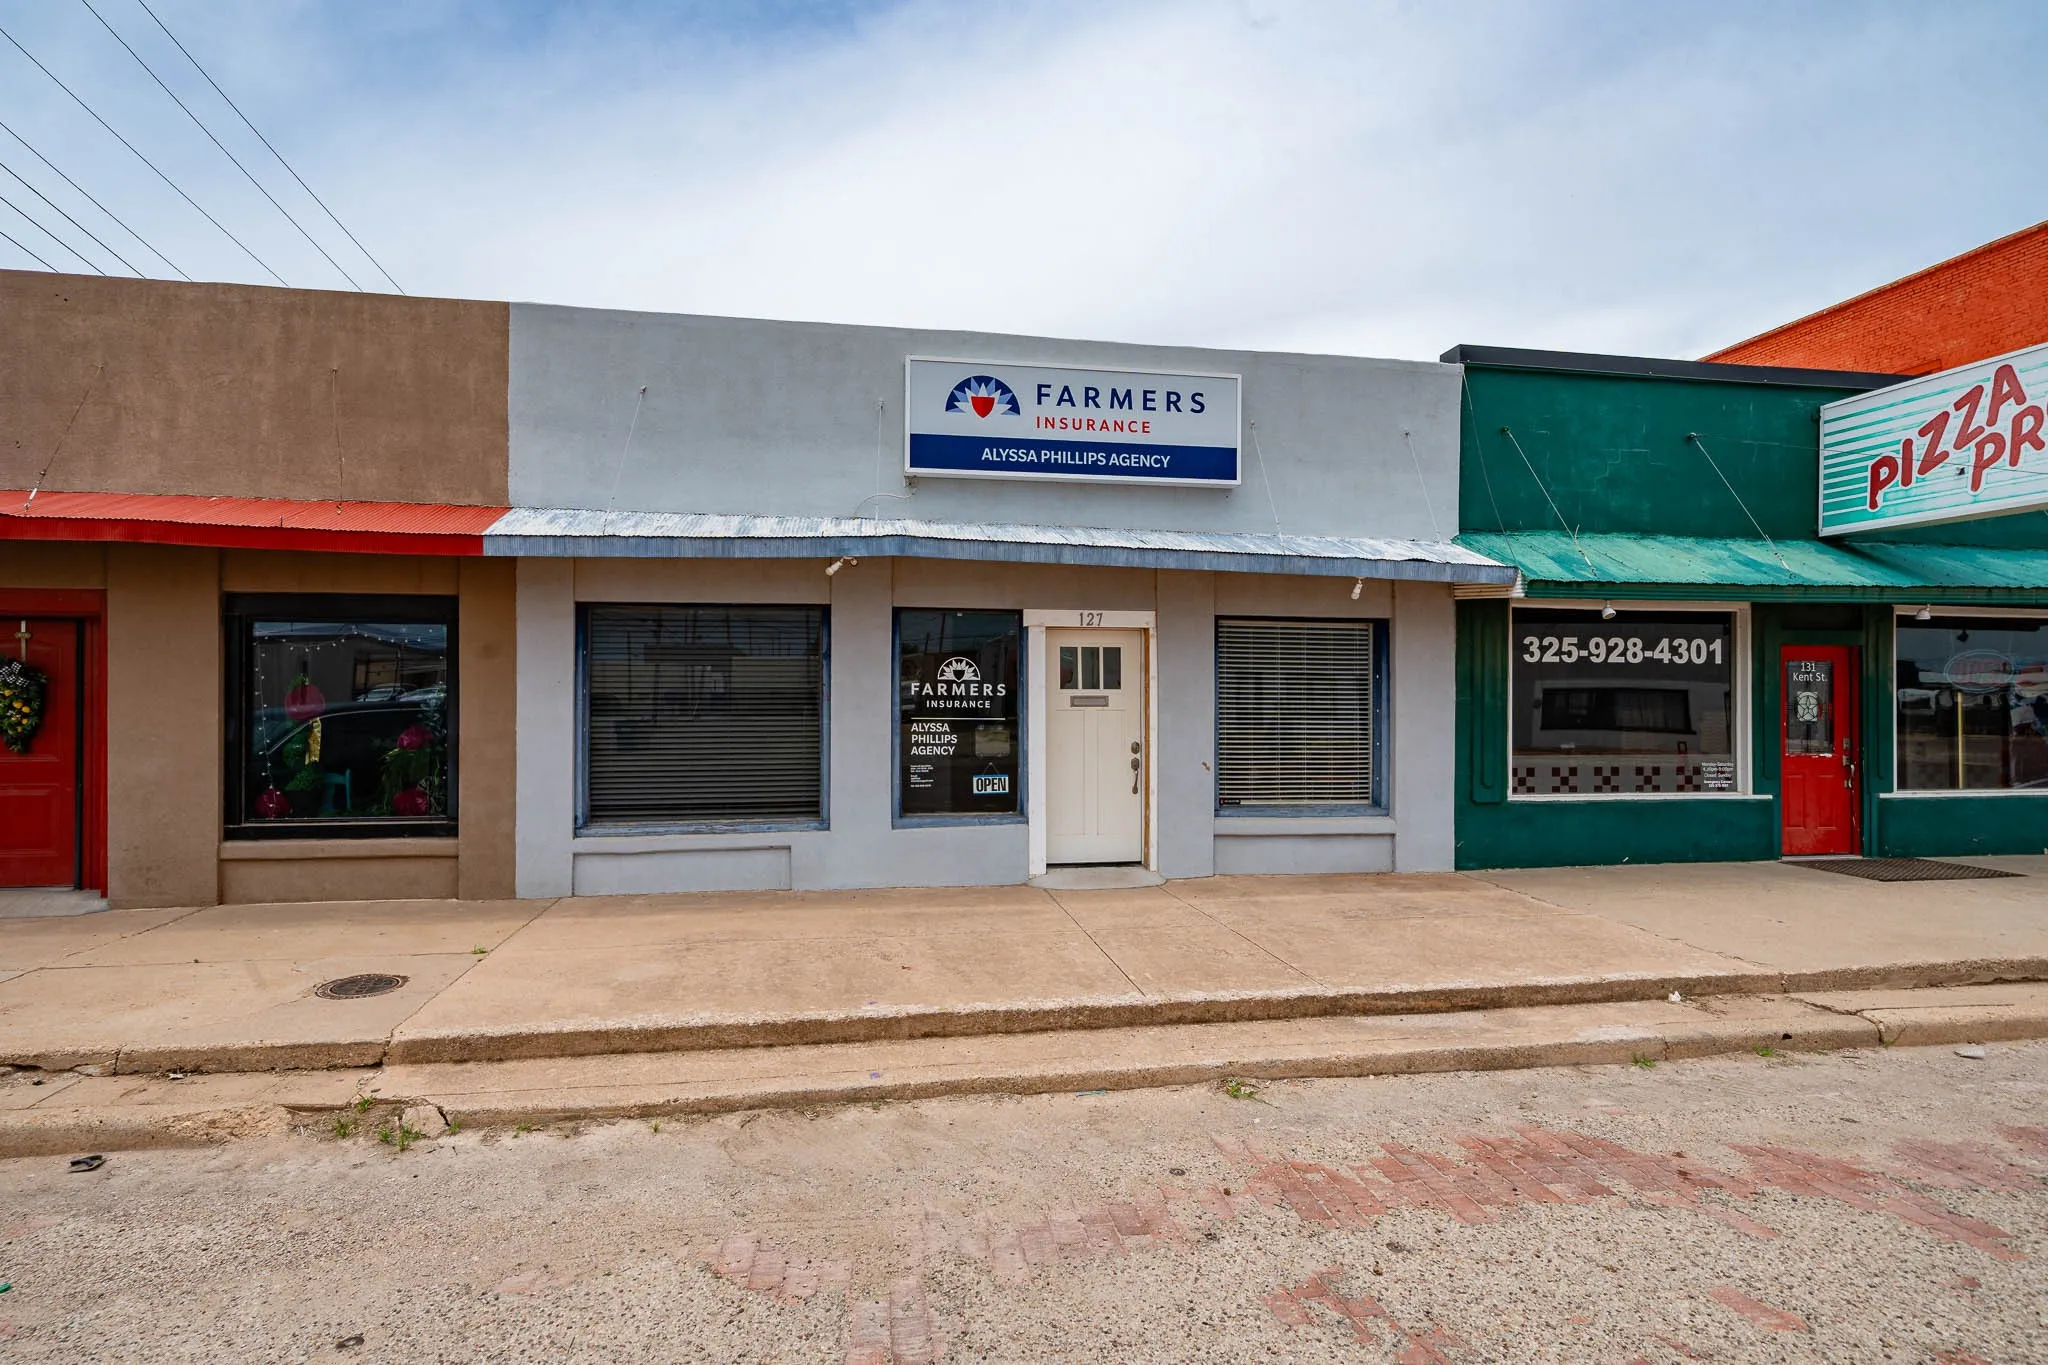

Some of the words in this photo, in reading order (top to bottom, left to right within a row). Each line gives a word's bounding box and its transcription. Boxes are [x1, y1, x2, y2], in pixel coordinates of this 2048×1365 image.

[1036, 384, 1206, 413] FARMERS
[1036, 416, 1151, 433] INSURANCE
[1868, 363, 2027, 510] PIZZA
[1970, 400, 2048, 492] PR
[981, 448, 1038, 463] ALYSSA
[1040, 451, 1106, 466] PHILLIPS
[1108, 454, 1171, 468] AGENCY
[1079, 612, 1104, 627] 127
[1522, 636, 1723, 665] 325-928-4301
[1800, 662, 1816, 672] 131
[1792, 672, 1813, 682] Kent
[1815, 672, 1828, 682] St.
[910, 683, 1006, 696] FARMERS
[926, 700, 991, 709] INSURANCE
[910, 722, 950, 732] ALYSSA
[911, 734, 958, 744] PHILLIPS
[910, 746, 956, 756] AGENCY
[976, 776, 1007, 792] OPEN
